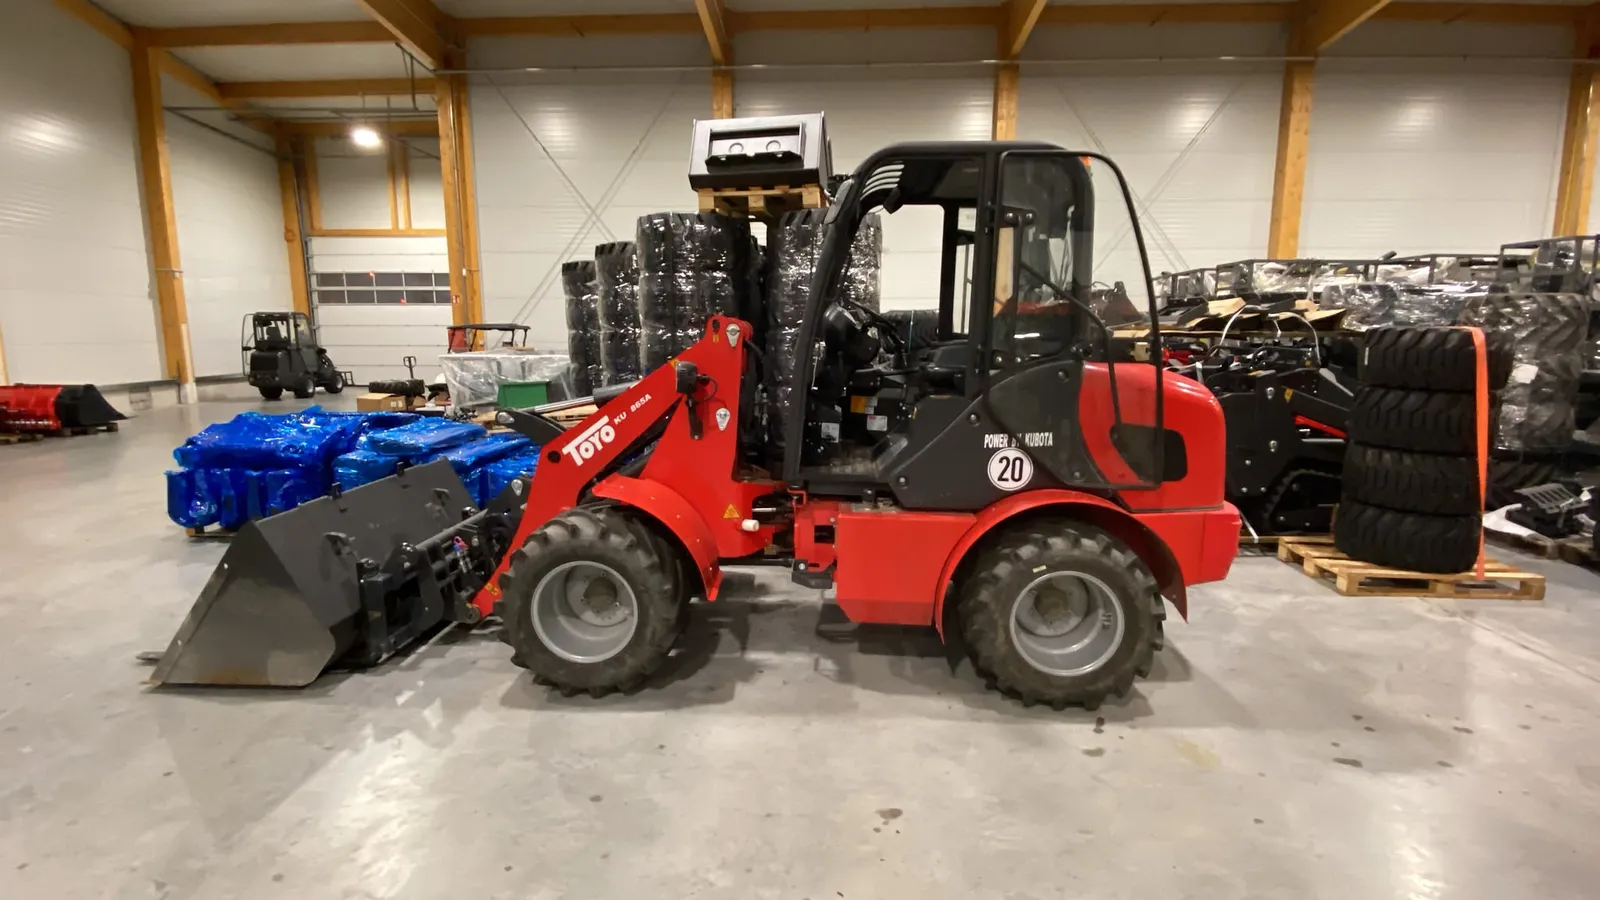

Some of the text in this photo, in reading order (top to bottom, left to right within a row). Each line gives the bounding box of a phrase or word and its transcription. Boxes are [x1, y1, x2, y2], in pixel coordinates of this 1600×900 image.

[562, 393, 652, 466] TOYO KU 865A
[984, 433, 1009, 448] POWER
[1024, 432, 1053, 447] KUBOTA
[997, 456, 1024, 482] 20
